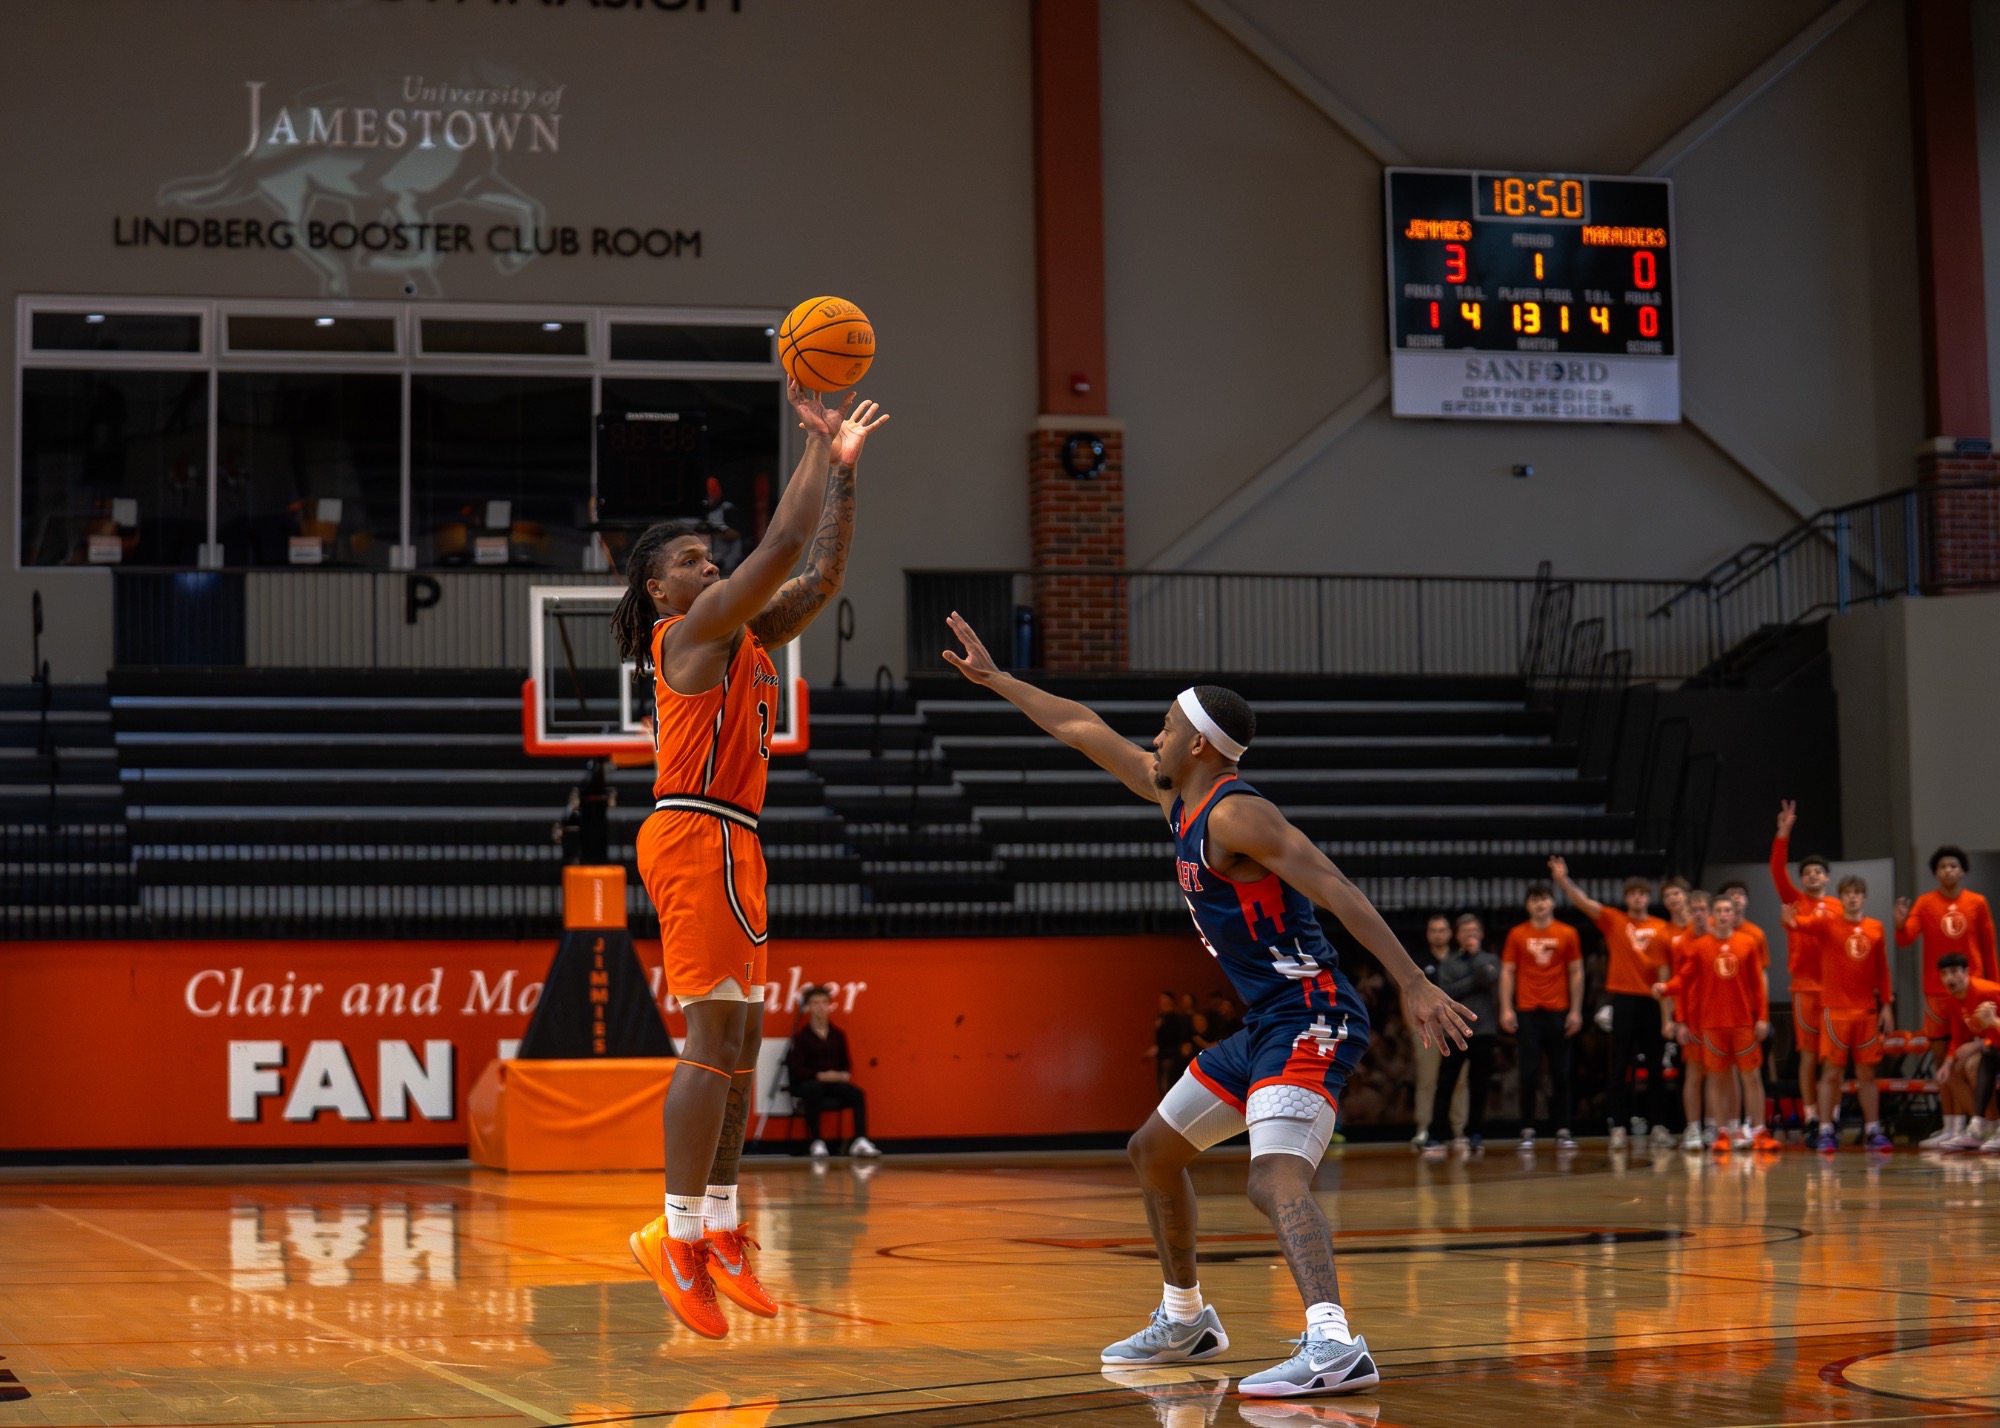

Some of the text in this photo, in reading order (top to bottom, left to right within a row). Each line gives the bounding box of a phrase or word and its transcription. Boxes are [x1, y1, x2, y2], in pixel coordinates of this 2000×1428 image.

[401, 76, 566, 112] University of
[244, 81, 563, 157] JAMESTOWN
[1493, 177, 1584, 218] 18:50
[113, 216, 702, 259] LINDBERG BOOSTER CLUB ROOM
[1582, 225, 1667, 248] MARAUDERS
[1445, 243, 1467, 283] 3
[1534, 252, 1544, 280] 1
[1633, 250, 1657, 290] 0
[1430, 301, 1440, 329] 1
[1461, 302, 1481, 330] 4
[1513, 302, 1541, 334] 13
[1560, 305, 1570, 333] 1
[1590, 306, 1610, 334] 4
[1639, 305, 1659, 337] 0
[1465, 358, 1609, 383] SANFORD
[1441, 400, 1634, 417] SPORTS MEDICINE
[1462, 386, 1613, 402] ORTHOPEDICS
[405, 575, 441, 625] P
[185, 967, 324, 1017] Clair
[340, 967, 445, 1016] and
[589, 937, 609, 1054] JIMMIES
[228, 1040, 455, 1121] FAN
